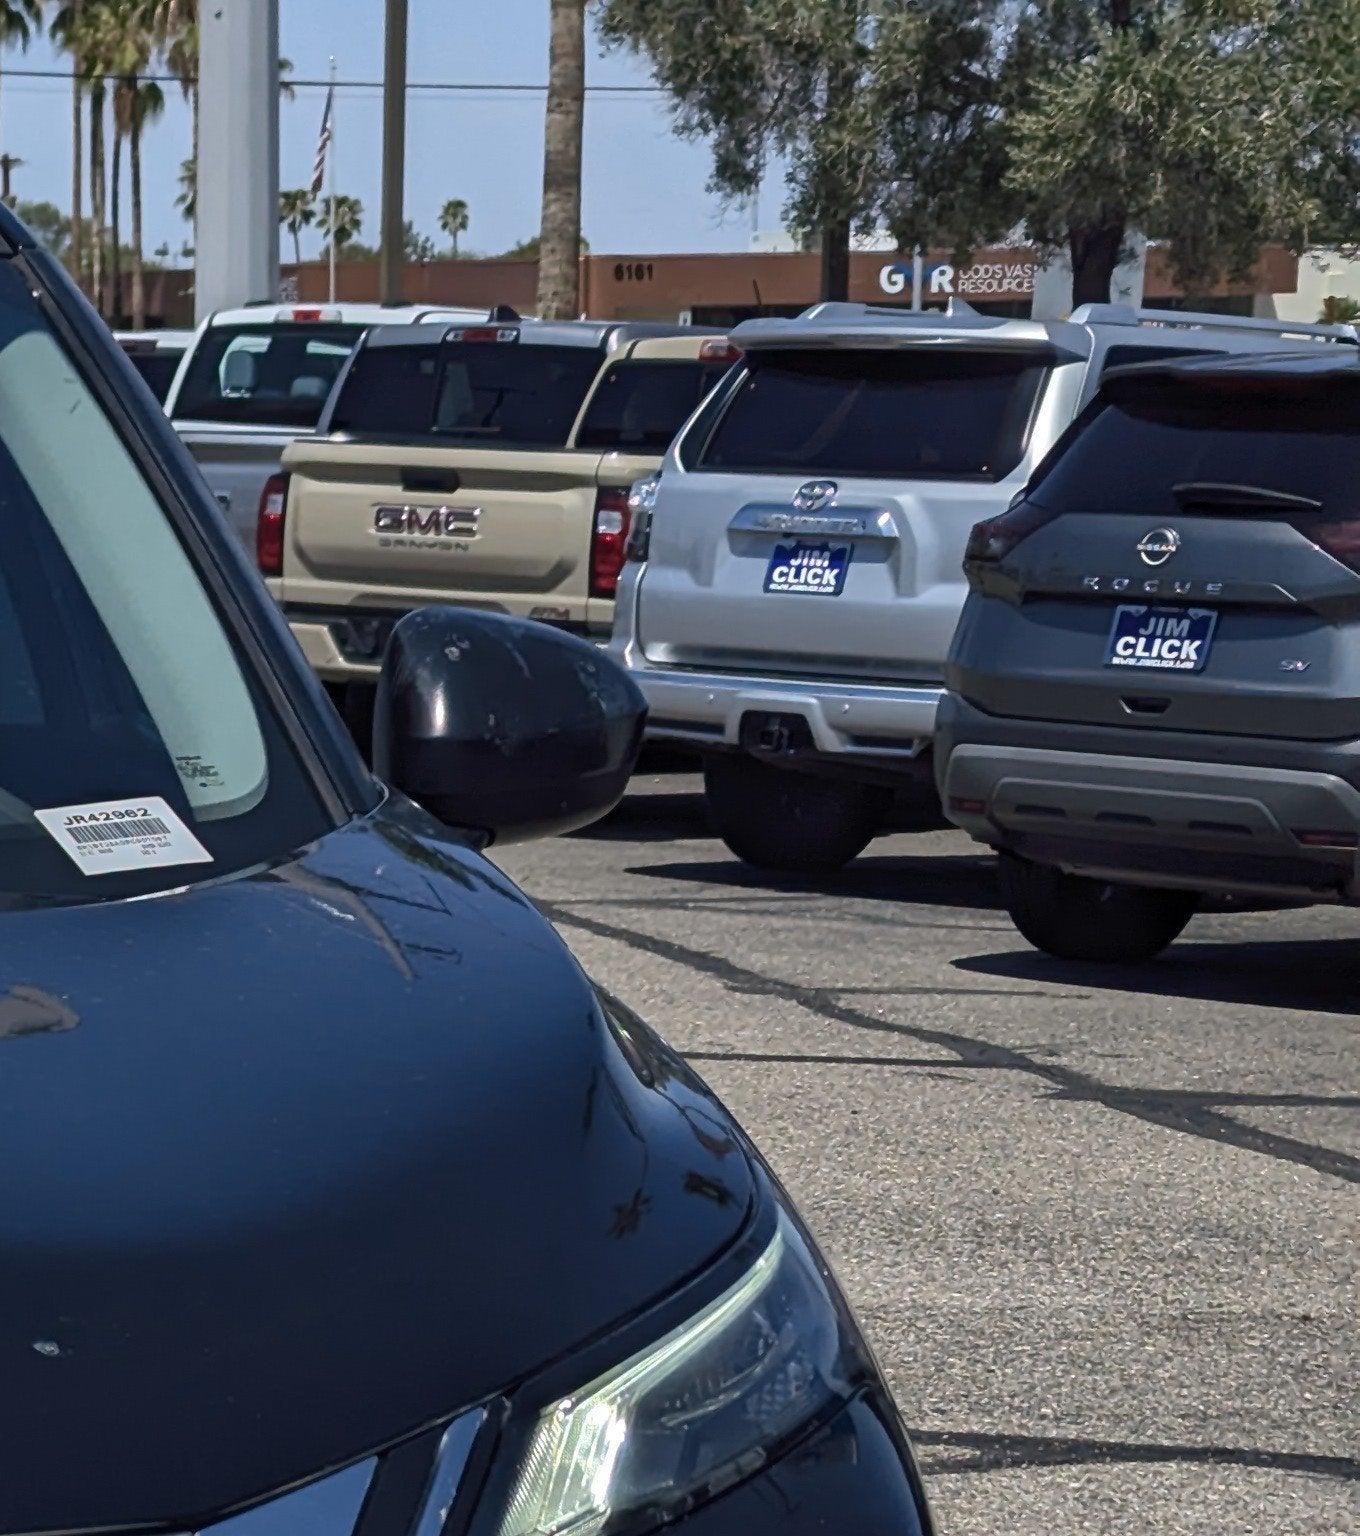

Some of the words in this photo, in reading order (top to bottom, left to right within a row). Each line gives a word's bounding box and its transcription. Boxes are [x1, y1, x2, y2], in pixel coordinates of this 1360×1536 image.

[614, 263, 653, 281] 6161
[375, 507, 480, 537] GMC
[789, 550, 830, 567] JIM
[772, 566, 840, 585] CLICK
[1083, 576, 1224, 595] ROGUE
[1138, 616, 1191, 637] JIM
[1115, 636, 1203, 661] CLICK
